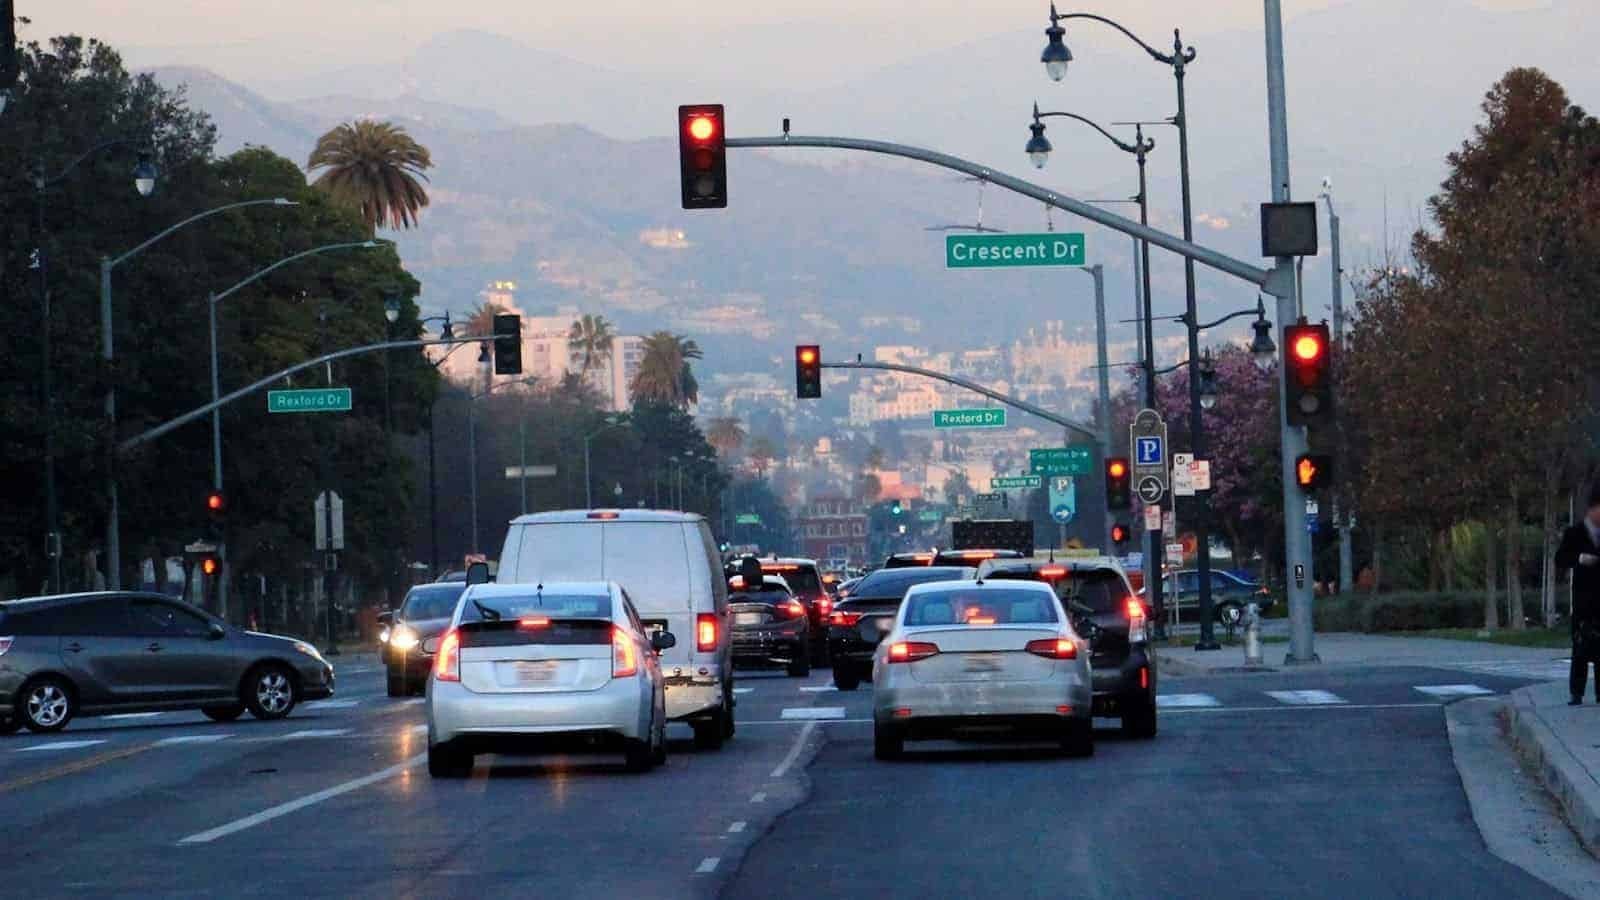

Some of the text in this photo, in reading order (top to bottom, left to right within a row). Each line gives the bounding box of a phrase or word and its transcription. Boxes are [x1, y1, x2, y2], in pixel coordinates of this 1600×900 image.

[952, 241, 1078, 260] Crescent Dr
[278, 393, 342, 407] Rexford Dr
[941, 412, 999, 423] Rexford Dr
[1142, 440, 1157, 461] P
[1057, 479, 1068, 491] P
